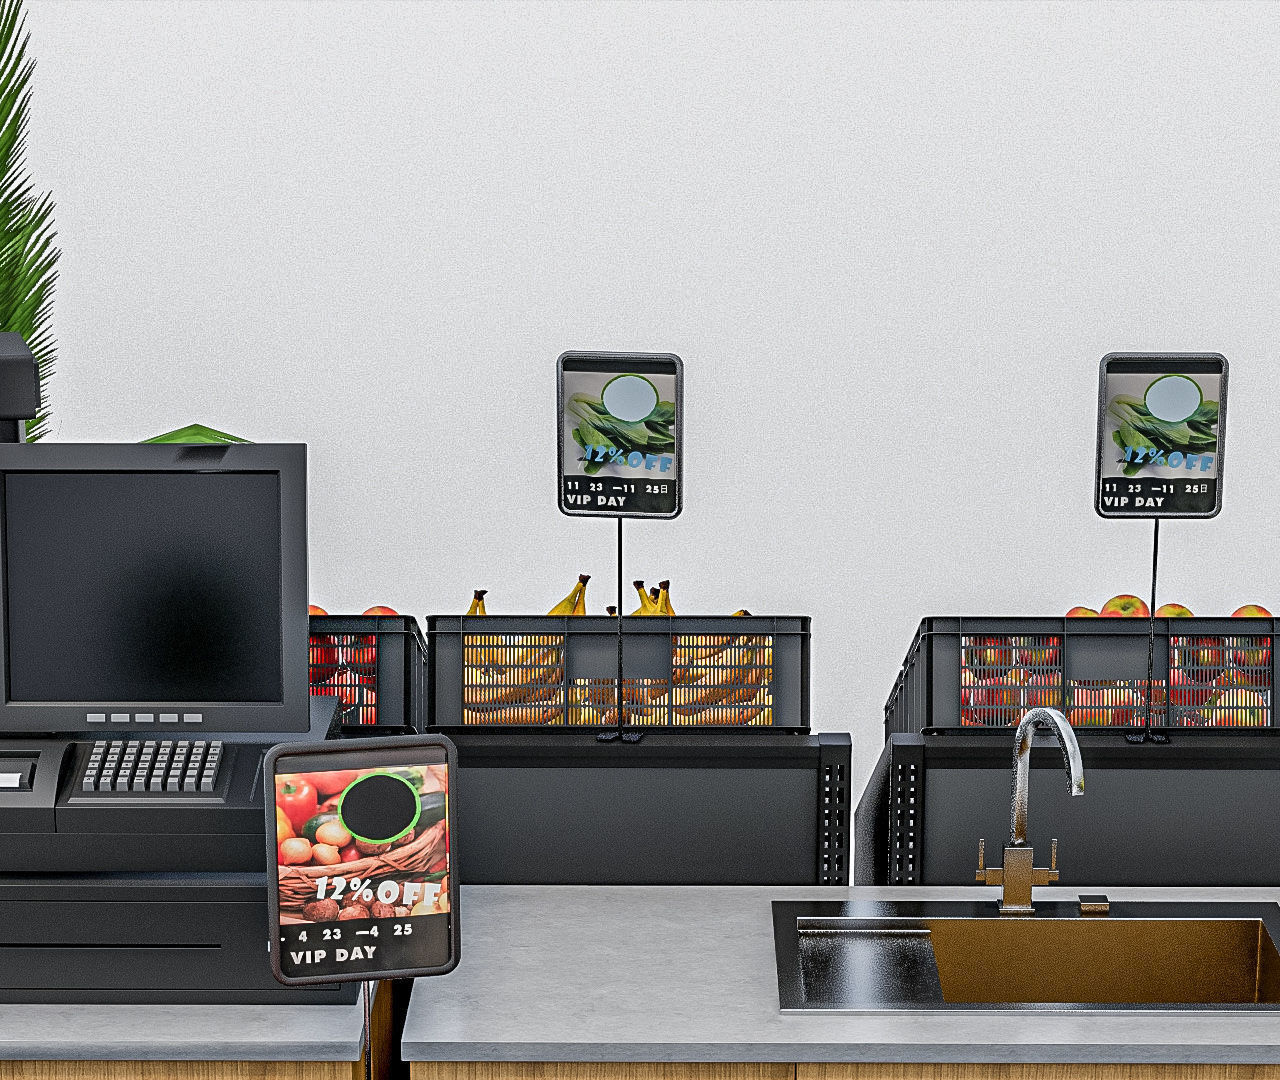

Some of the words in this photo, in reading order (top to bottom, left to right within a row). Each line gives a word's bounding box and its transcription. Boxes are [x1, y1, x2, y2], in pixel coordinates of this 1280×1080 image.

[590, 483, 602, 491] 23
[567, 495, 591, 504] VIP
[598, 496, 626, 506] DAY
[1104, 497, 1128, 506] VIP
[1135, 497, 1164, 506] DAY
[299, 931, 307, 942] 4
[322, 929, 341, 940] 23
[393, 924, 412, 935] 25
[290, 950, 326, 965] VIP
[336, 946, 376, 961] DAY
